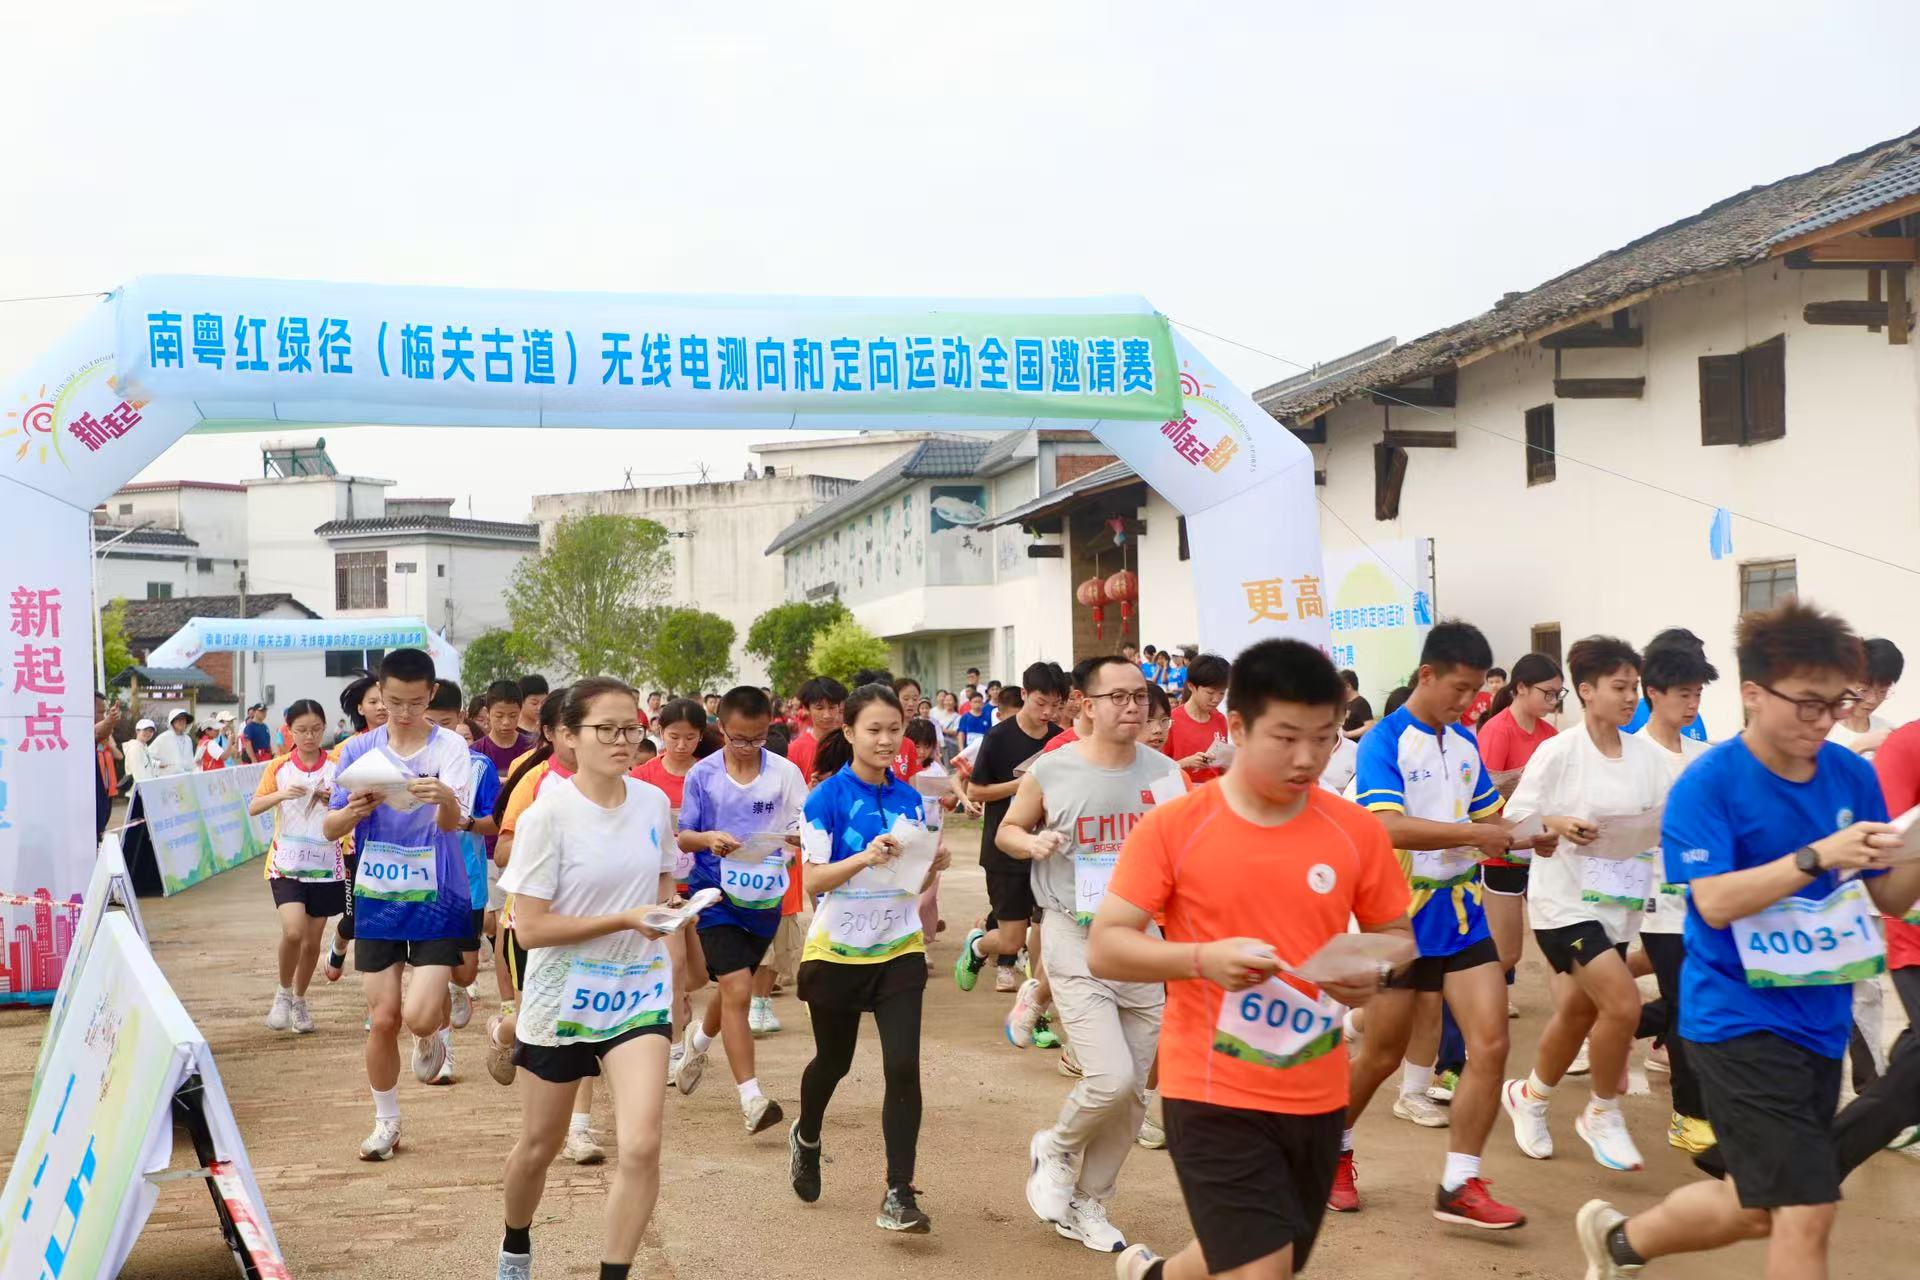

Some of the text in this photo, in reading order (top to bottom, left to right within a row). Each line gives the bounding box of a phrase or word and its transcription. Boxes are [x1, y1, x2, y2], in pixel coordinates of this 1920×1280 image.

[147, 311, 1155, 393] 南粤红绿径（梅关古道）无线电测向和定向运动全国邀请赛
[1241, 574, 1325, 625] 更高
[9, 585, 69, 753] 新起点
[363, 861, 429, 881] 2001-1
[1749, 916, 1871, 955] 4003-1
